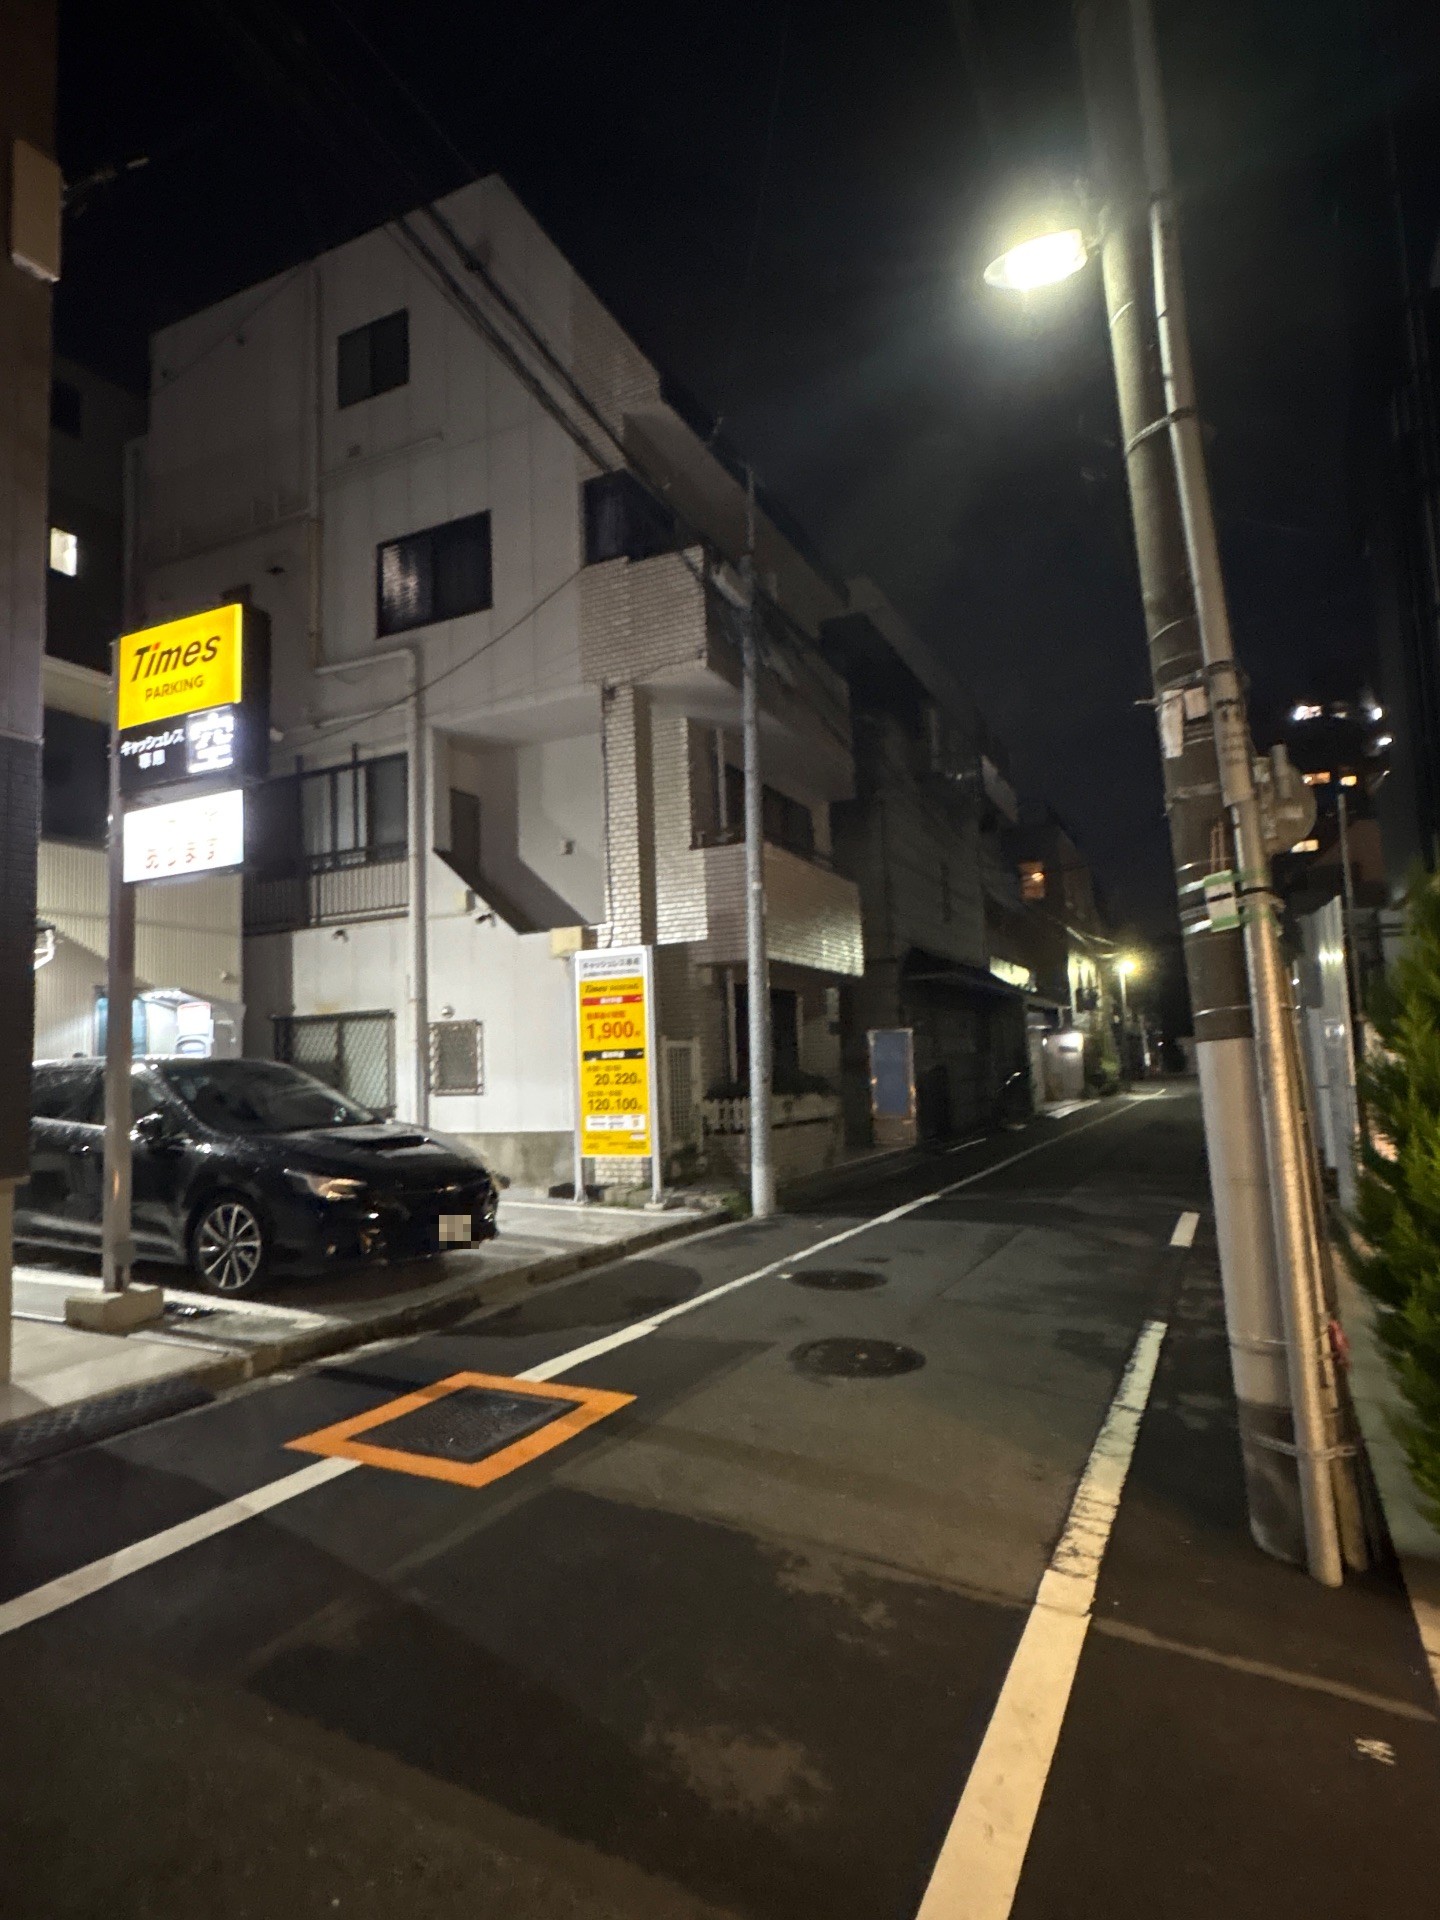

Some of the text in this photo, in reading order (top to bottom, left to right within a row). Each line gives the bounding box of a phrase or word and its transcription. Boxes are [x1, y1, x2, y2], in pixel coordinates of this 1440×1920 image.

[130, 634, 221, 684] Times
[144, 674, 205, 703] PARKING
[120, 728, 186, 757] キャッシュレス
[187, 712, 235, 774] 空
